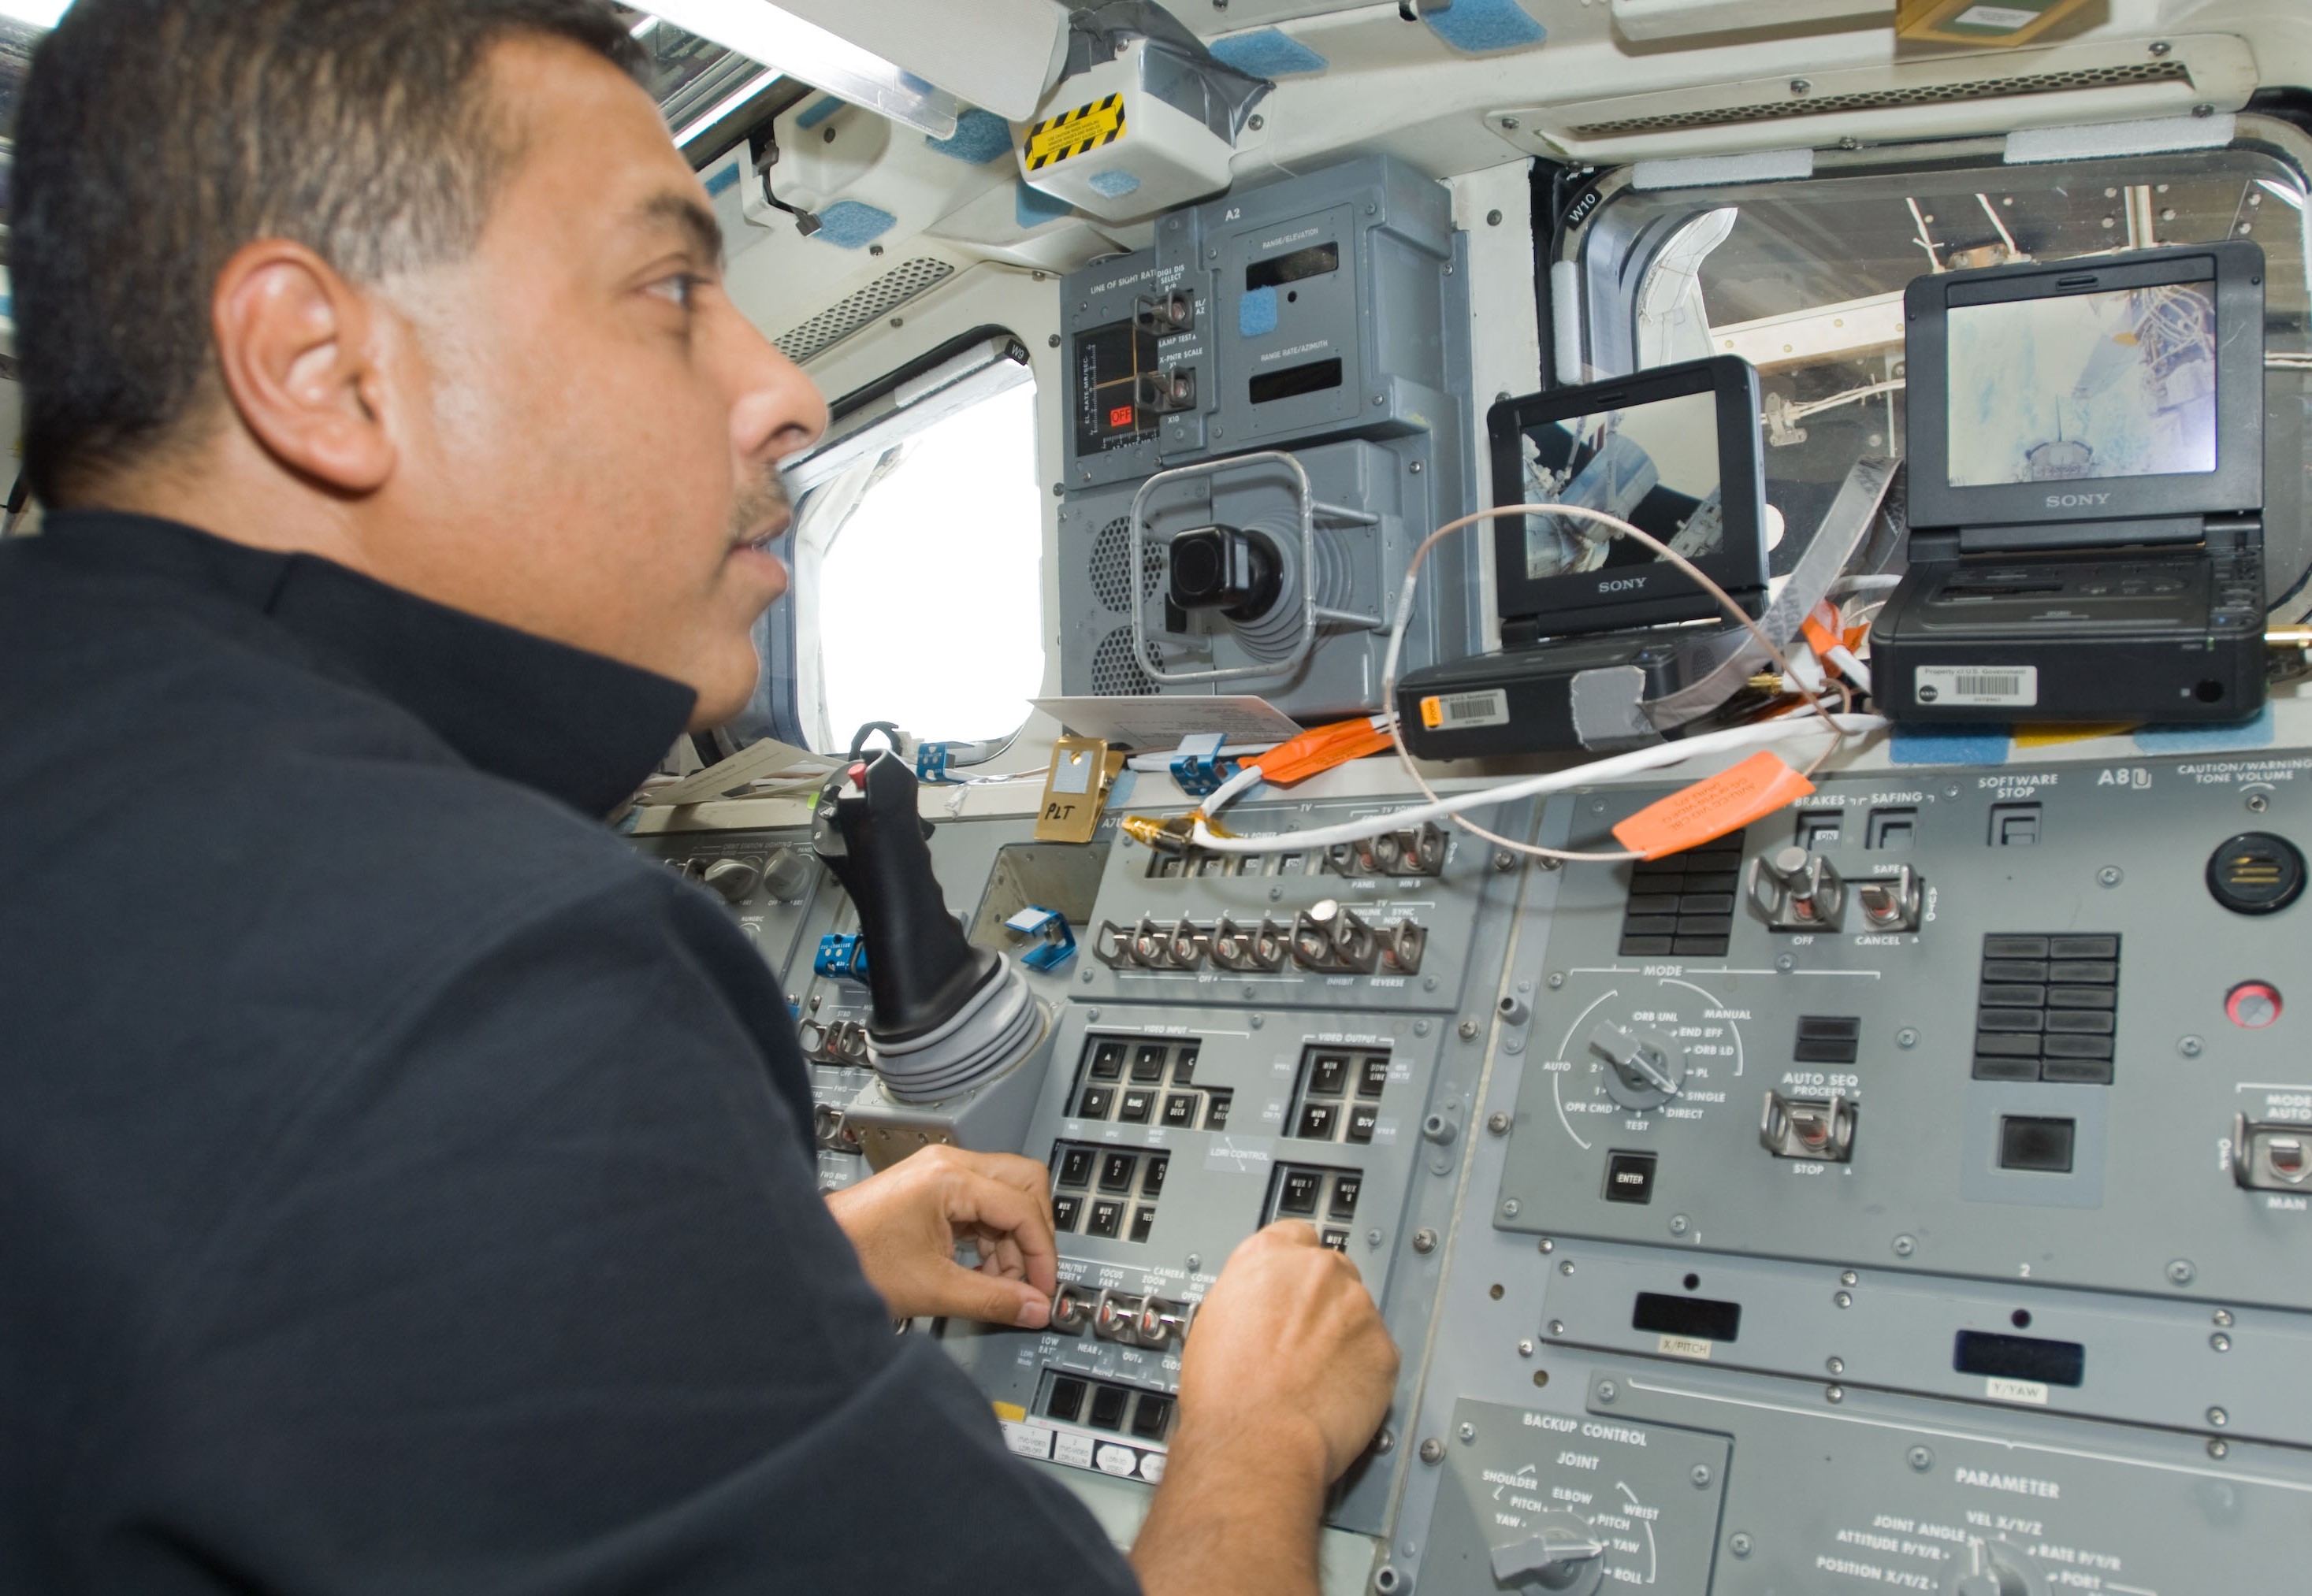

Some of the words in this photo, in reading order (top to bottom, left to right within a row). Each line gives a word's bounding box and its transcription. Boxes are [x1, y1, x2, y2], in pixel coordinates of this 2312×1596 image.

[1569, 194, 1596, 221] W10
[1225, 208, 1240, 221] A2
[1262, 227, 1318, 250] RANGE/ELEVATION
[1157, 268, 1172, 277] DIGI
[1161, 273, 1181, 284] SELECT
[1091, 284, 1106, 294] LINE
[1107, 280, 1116, 289] OF
[1118, 275, 1139, 286] SIGHT
[1158, 336, 1176, 347] LAMP
[1179, 334, 1191, 343] TEST
[1012, 344, 1024, 359] W9
[1159, 351, 1183, 364] X-PNTR
[1184, 347, 1202, 358] SCALE
[1261, 351, 1281, 361] RANGE
[1282, 340, 1328, 356] RATE/AZIMUTH
[1111, 410, 1131, 423] OFF
[2046, 493, 2111, 507] SONY
[1599, 577, 1647, 592] SONY
[2177, 759, 2312, 774] CAUTION/WARNING
[1979, 774, 2059, 788] SOFTWARE
[2196, 774, 2232, 784] TONE
[2236, 770, 2295, 781] VOLUME
[1871, 792, 1923, 804] SAFING
[1997, 787, 2035, 799] STOP
[1794, 795, 1846, 807] BRAKES
[1044, 802, 1075, 820] PLT
[1300, 803, 1312, 812] TV
[1873, 865, 1900, 874] SAFE
[1925, 887, 1938, 922] AUTO
[1793, 937, 1814, 945] OFF
[1855, 937, 1901, 945] CANCEL
[1643, 965, 1682, 976] MODE
[1326, 977, 1354, 985] INHIBIT
[1370, 978, 1405, 987] REVERSE
[1632, 1011, 1655, 1021] ORB
[1657, 1012, 1678, 1022] UNL
[1704, 1009, 1752, 1019] MANUAL
[1167, 1026, 1188, 1034] INPUT
[1678, 1026, 1702, 1037] END
[1704, 1027, 1723, 1037] EFF
[1318, 1034, 1342, 1042] VIDEO
[1344, 1034, 1377, 1043] OUTPUT
[1694, 1045, 1717, 1055] ORB
[1719, 1045, 1734, 1056] LD
[1543, 1062, 1571, 1071] AUTO
[1589, 1064, 1597, 1073] 2
[1695, 1068, 1708, 1078] PL
[1782, 1072, 1824, 1085] AUTO
[1829, 1073, 1859, 1086] SEQ
[1686, 1091, 1726, 1102] SINGLE
[1793, 1086, 1846, 1096] PROCEED
[2266, 1094, 2312, 1105] MODE
[1566, 1103, 1586, 1112] OPR
[1589, 1103, 1612, 1114] CMD
[1666, 1108, 1704, 1119] DIRECT
[2268, 1108, 2311, 1120] AUTO
[1625, 1120, 1649, 1130] TEST
[1230, 1149, 1269, 1161] CONTROL
[1793, 1164, 1824, 1175] STOP
[1291, 1178, 1307, 1187] MUX
[1618, 1174, 1644, 1184] ENTER
[2267, 1197, 2307, 1210] MAN
[1326, 1234, 1342, 1245] MUX
[1099, 1268, 1124, 1279] FOCUS
[1153, 1268, 1184, 1280] CAMERA
[2020, 1264, 2030, 1277] 2
[1098, 1279, 1114, 1287] FAR
[1142, 1275, 1166, 1286] ZOOM
[1190, 1282, 1205, 1292] IRIS
[1181, 1291, 1202, 1302] OPEN
[1041, 1336, 1061, 1346] LOW
[1077, 1343, 1098, 1355] NEAR
[1664, 1340, 1707, 1355] X/PITCH
[1122, 1352, 1137, 1363] OUT
[1994, 1382, 2039, 1397] Y/YAW
[1523, 1413, 1578, 1434] BACKUP
[1581, 1423, 1648, 1446] CONTROL
[1556, 1451, 1600, 1470] JOINT
[1481, 1468, 1537, 1490] SHOULDER
[1955, 1467, 2060, 1499] PARAMETER
[1552, 1487, 1593, 1505] ELBOW
[1511, 1496, 1542, 1512] PITCH
[1622, 1503, 1660, 1520] WRIST
[1496, 1512, 1520, 1527] YAW
[1597, 1514, 1630, 1531] PITCH
[1966, 1509, 1991, 1527] VEL
[1995, 1516, 2043, 1536] X/Y/Z
[1872, 1514, 1915, 1533] JOINT
[1917, 1523, 1965, 1542] ANGLE
[1613, 1538, 1640, 1553] YAW
[1836, 1529, 1898, 1552] ATTITUDE
[1901, 1541, 1941, 1560] P/Y/R
[2039, 1544, 2075, 1563] RATE
[2079, 1551, 2121, 1571] P/Y/R
[1614, 1568, 1642, 1584] ROLL
[1816, 1555, 1882, 1580] POSITION
[1885, 1569, 1929, 1590] X/Y/Z
[2061, 1570, 2101, 1590] PORT
